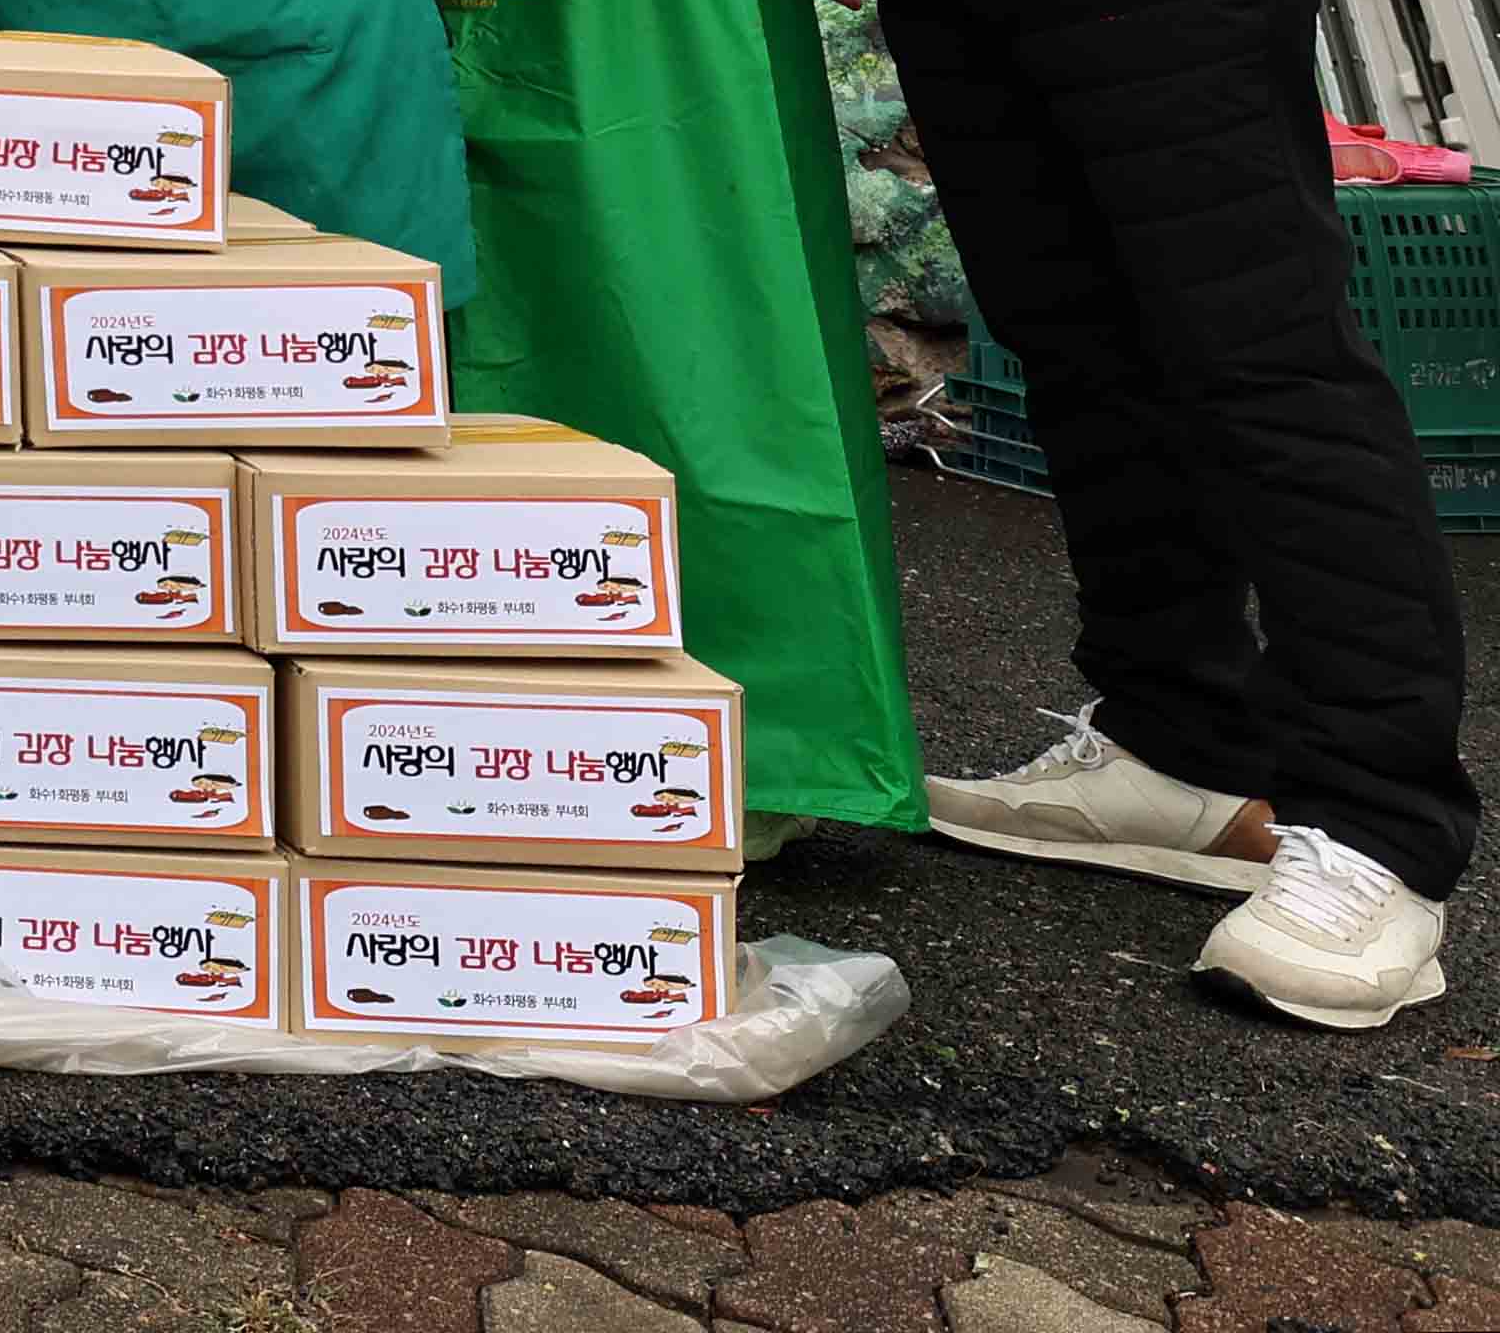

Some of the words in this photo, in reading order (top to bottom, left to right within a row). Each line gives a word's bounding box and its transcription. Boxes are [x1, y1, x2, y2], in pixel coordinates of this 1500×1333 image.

[88, 313, 158, 330] 2024년도
[83, 333, 175, 366] 사랑의
[188, 334, 249, 365] 김장
[321, 525, 390, 542] 2024년도
[314, 546, 407, 578] 사랑의
[420, 548, 482, 579] 김장
[367, 722, 439, 740] 2024년도
[360, 742, 456, 777] 사랑의
[471, 748, 534, 780] 김장
[350, 910, 424, 930] 2024년도
[343, 931, 441, 967] 사랑의
[455, 937, 520, 971] 김장
